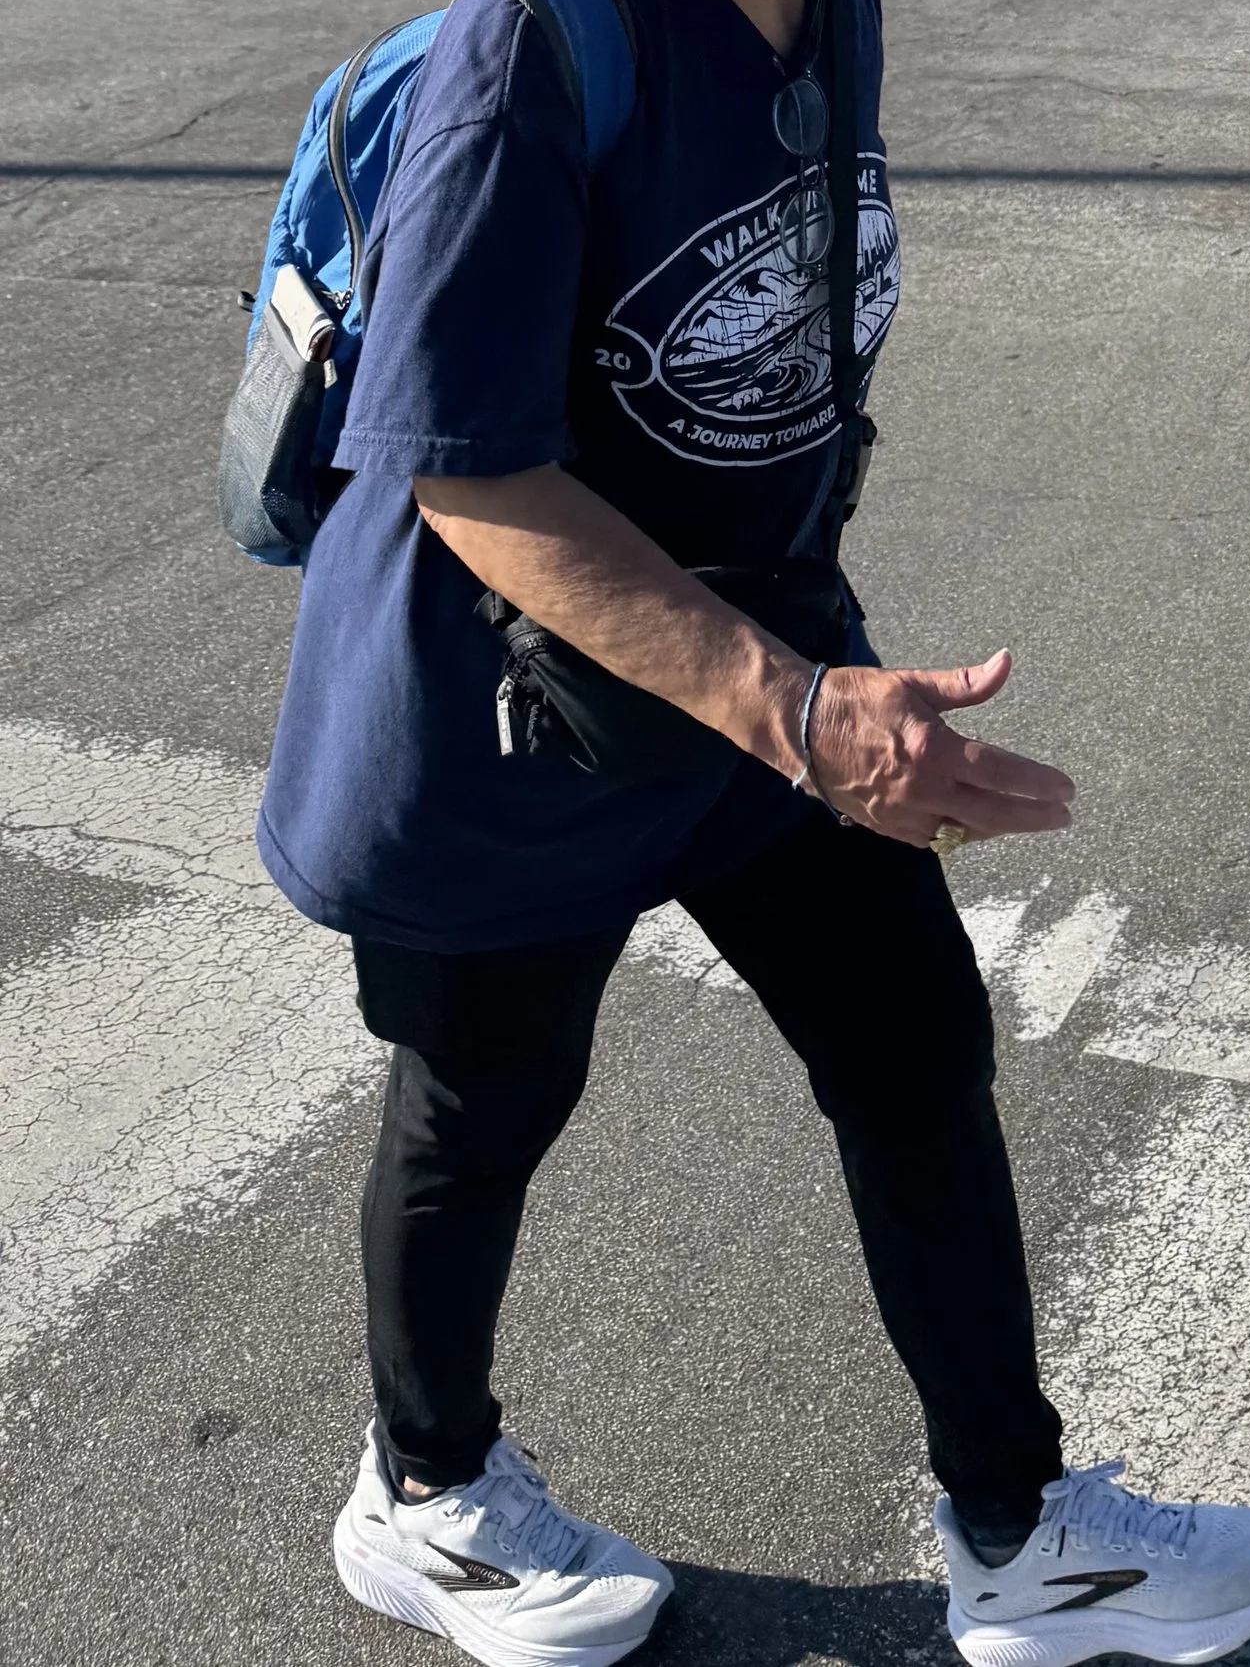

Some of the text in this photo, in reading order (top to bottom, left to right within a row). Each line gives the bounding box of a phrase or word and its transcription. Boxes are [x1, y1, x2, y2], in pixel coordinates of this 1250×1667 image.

[700, 201, 781, 268] WALK
[594, 348, 631, 370] 20
[667, 403, 836, 449] A JOURNEY TOWARD
